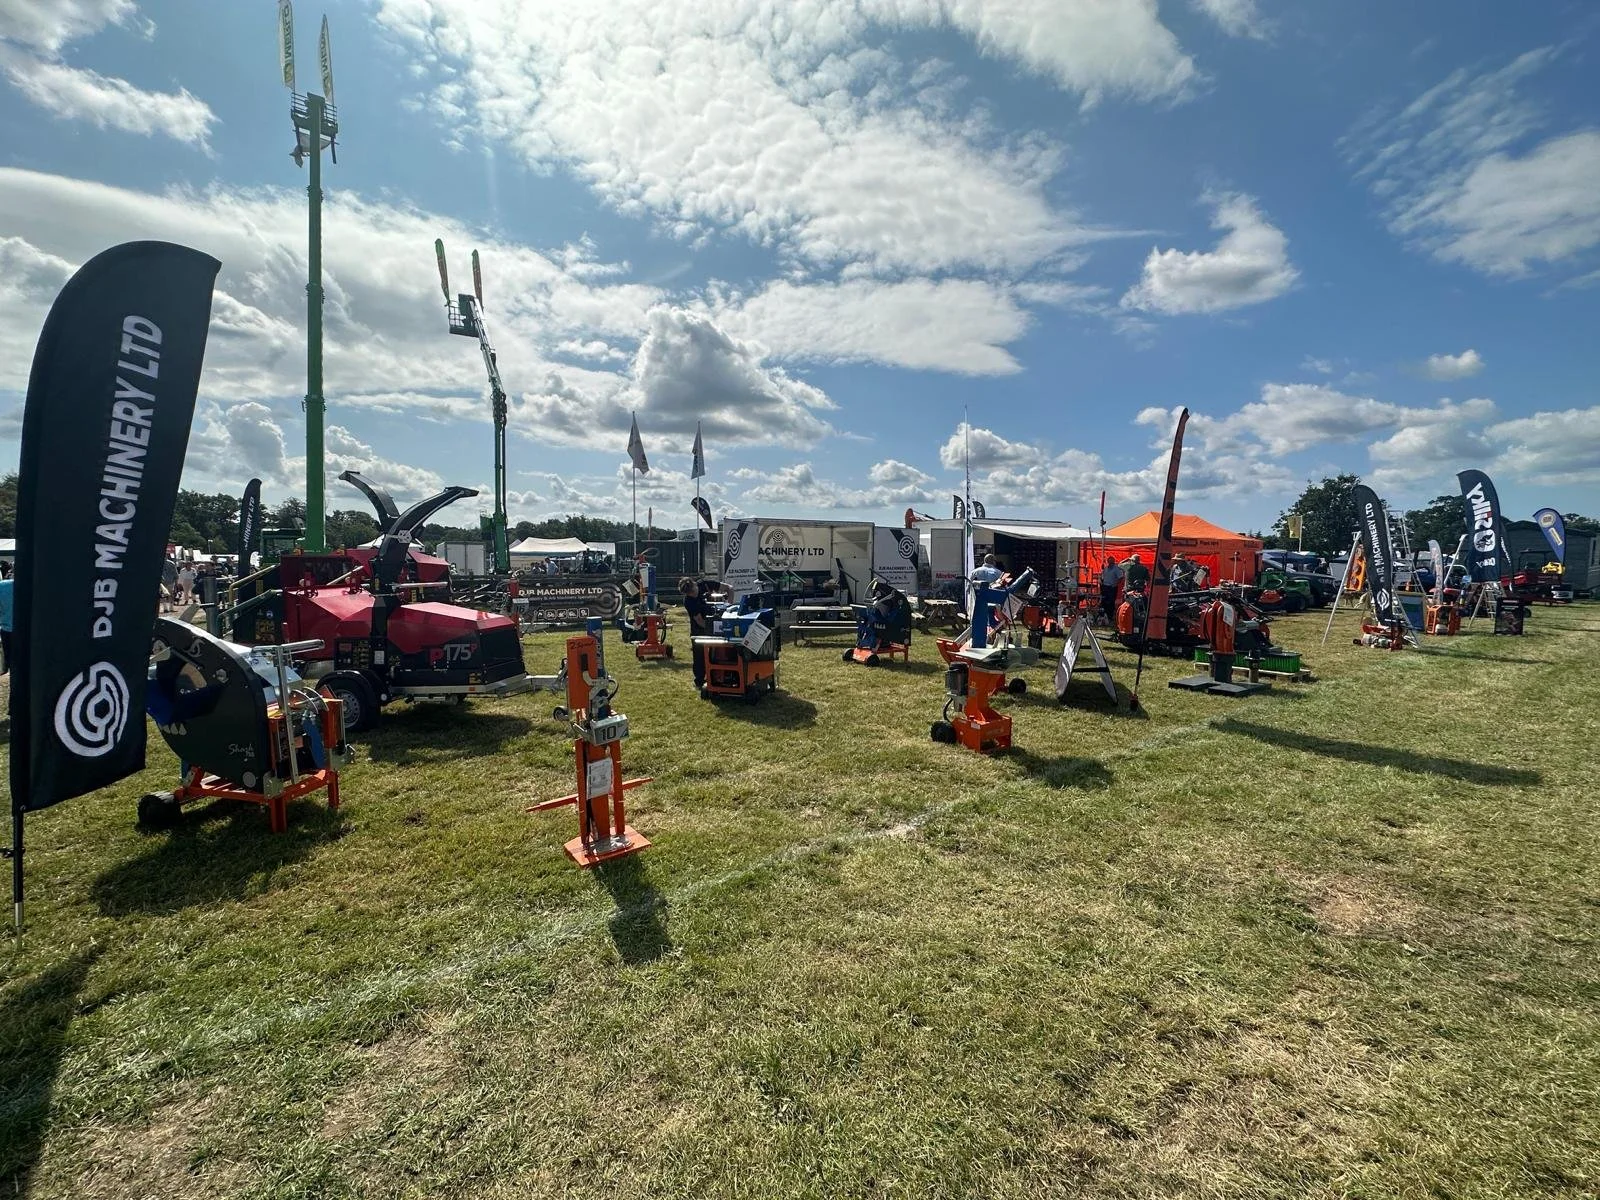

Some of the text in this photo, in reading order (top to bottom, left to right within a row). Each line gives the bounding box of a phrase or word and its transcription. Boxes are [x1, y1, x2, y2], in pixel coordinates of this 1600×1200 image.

[93, 314, 164, 638] DJB MACHINERY LTD
[1365, 502, 1375, 519] LTD
[1367, 519, 1385, 566] MACHINERY
[758, 547, 825, 556] ACHINERY LTD
[536, 587, 587, 596] MACHINERY
[587, 586, 603, 595] LTD
